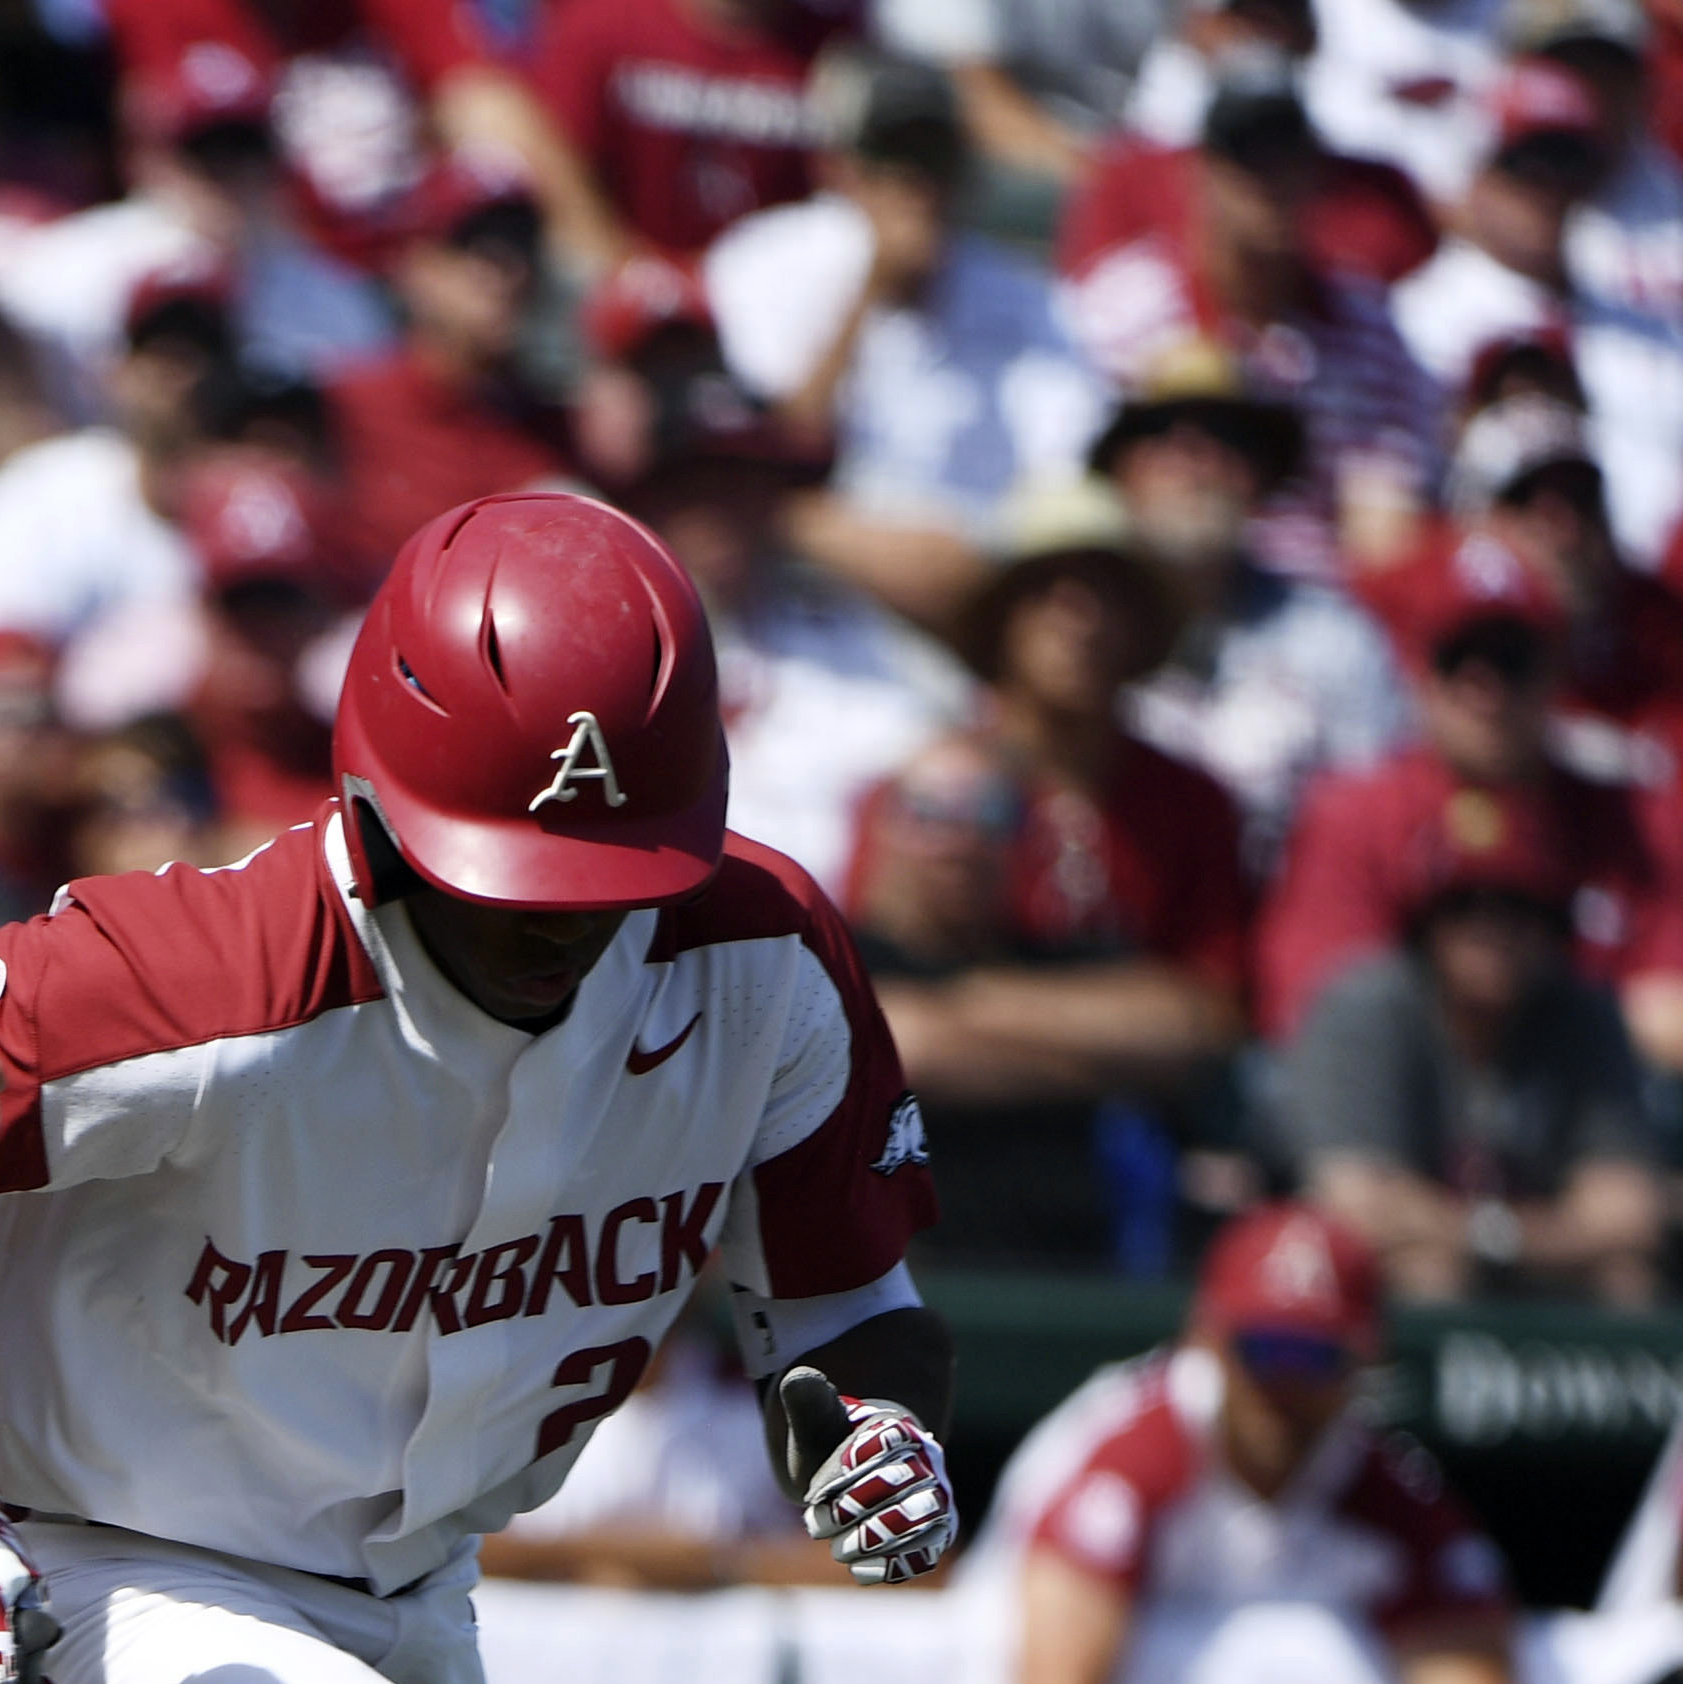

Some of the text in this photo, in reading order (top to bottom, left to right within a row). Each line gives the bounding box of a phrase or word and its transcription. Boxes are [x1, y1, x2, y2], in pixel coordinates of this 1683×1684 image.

[528, 710, 628, 812] A
[185, 1181, 726, 1347] RAZORBACK
[535, 1335, 651, 1463] 2
